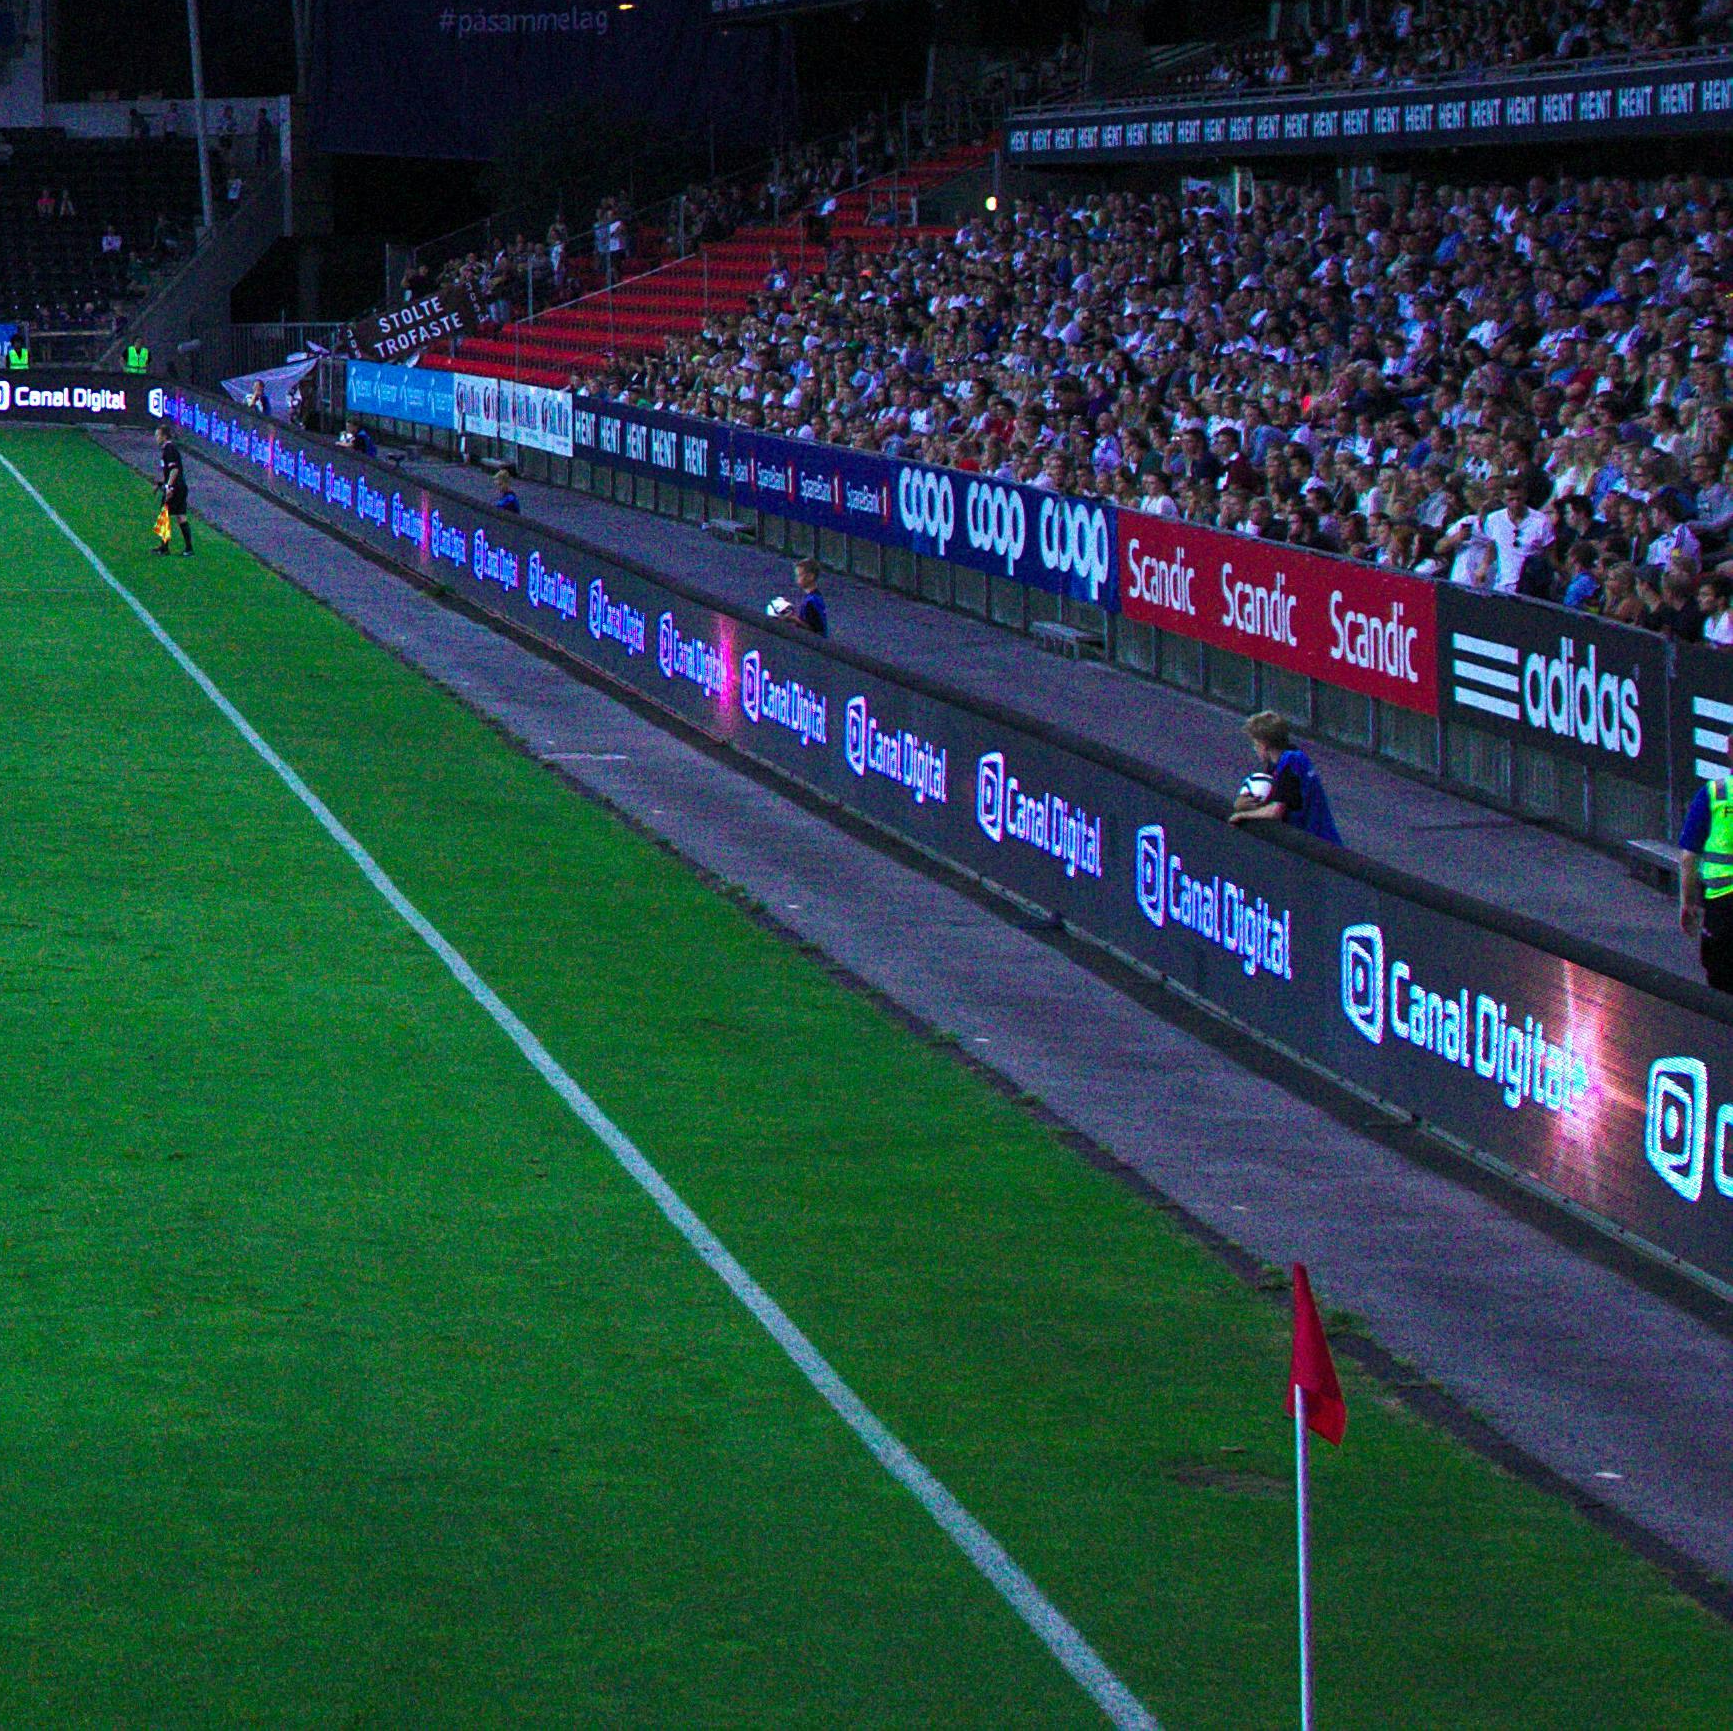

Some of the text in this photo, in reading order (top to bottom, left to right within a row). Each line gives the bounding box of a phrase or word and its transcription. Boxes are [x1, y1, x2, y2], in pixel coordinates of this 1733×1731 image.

[439, 6, 607, 38] #påsammelag
[374, 312, 464, 358] TROFASTE
[379, 296, 444, 334] STOLTE
[15, 385, 126, 412] Canal Digital
[576, 411, 595, 445] HENT
[601, 417, 621, 453] HENT
[627, 424, 647, 461] HENT
[652, 429, 676, 468] HENT
[685, 436, 708, 476] HENT
[900, 467, 954, 555] coop
[968, 482, 1025, 575] coop
[1041, 498, 1108, 600] coop
[1129, 539, 1195, 615] Scandic
[1222, 563, 1297, 646] Scandic
[1330, 590, 1418, 682] Scandic
[762, 670, 790, 726] Canal
[1525, 637, 1641, 757] adidas
[866, 717, 946, 803] Canal Digital
[1004, 777, 1101, 877] Canal Digital
[1169, 853, 1293, 982] Canal Digital
[1393, 962, 1470, 1067] Canal
